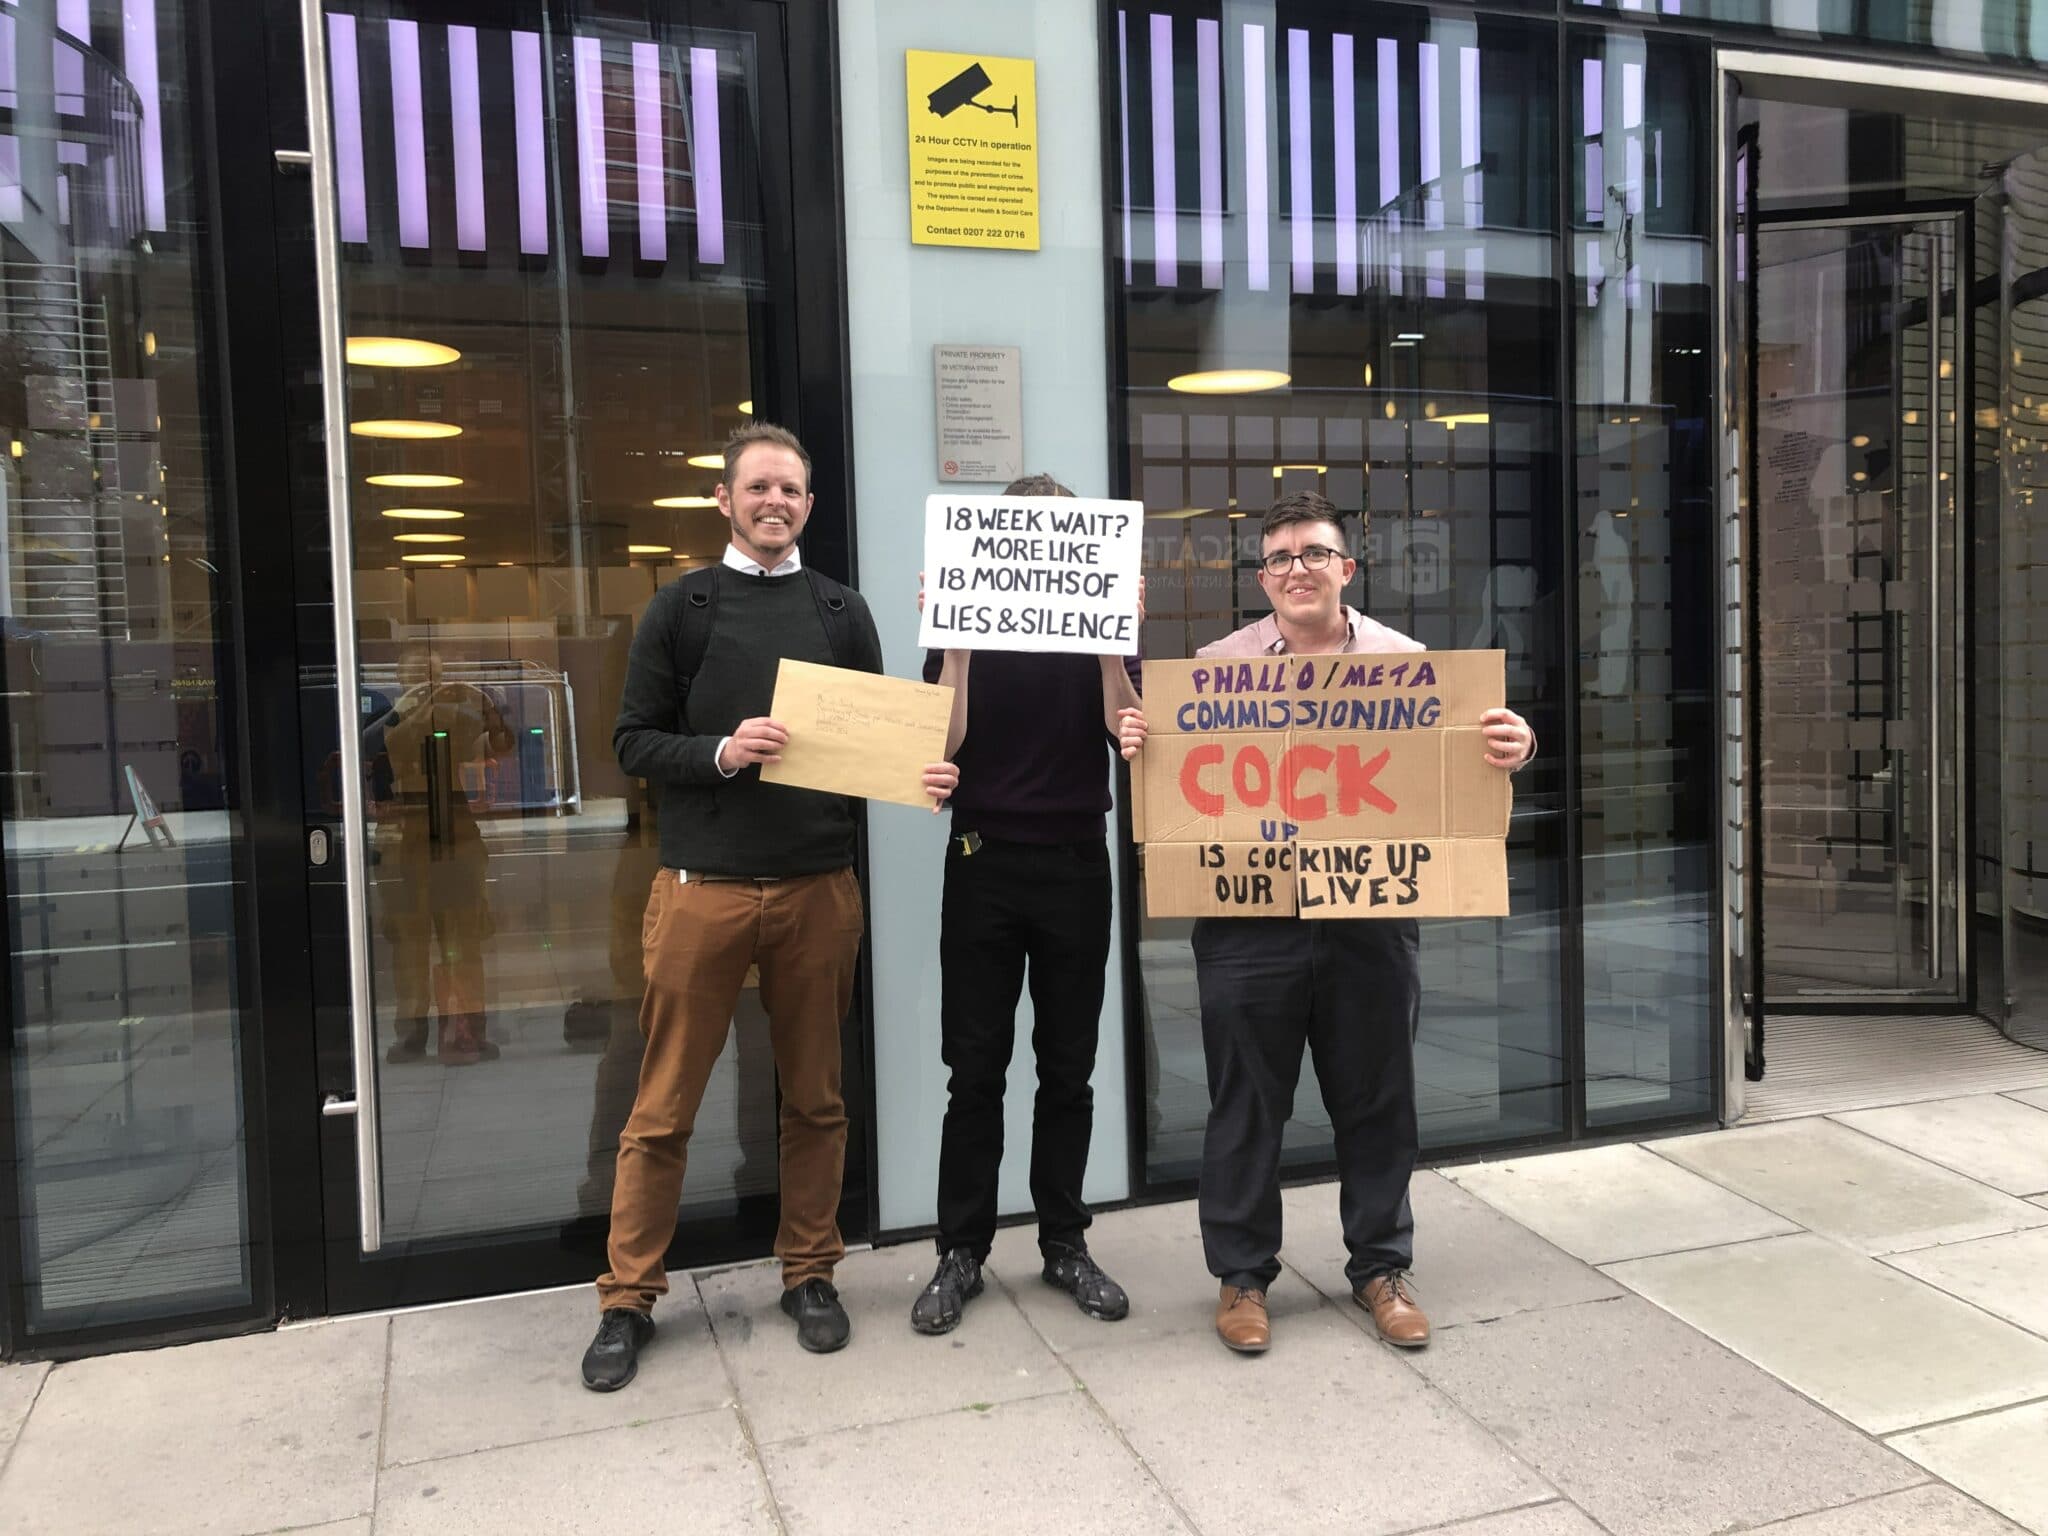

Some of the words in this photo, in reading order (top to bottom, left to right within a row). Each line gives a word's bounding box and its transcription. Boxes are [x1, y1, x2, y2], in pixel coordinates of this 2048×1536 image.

[915, 135, 926, 143] 24
[928, 135, 950, 145] Hour
[952, 137, 977, 147] CCTV
[990, 142, 1032, 151] operation
[926, 225, 961, 235] Contact
[963, 227, 984, 236] 0207
[986, 229, 1002, 237] 222
[1004, 230, 1025, 239] 0716
[941, 350, 968, 359] PRIVATE
[970, 351, 1006, 359] PROPERTY
[950, 364, 975, 372] VICTORIA
[946, 506, 973, 531] 18
[976, 508, 1044, 532] WEEK
[1049, 511, 1130, 538] WAIT?
[971, 536, 1044, 562] MORE
[1049, 540, 1101, 565] LIKE
[939, 567, 966, 591] 18
[971, 567, 1082, 595] MONTHS
[1083, 572, 1119, 599] OF
[932, 603, 993, 634] LIES
[996, 607, 1019, 633] &
[1020, 607, 1133, 641] SILENCE
[1176, 696, 1441, 732] COMMISSIONING
[1179, 743, 1398, 822] COCK
[1259, 819, 1300, 842] UP
[1199, 844, 1226, 869] IS
[1247, 844, 1373, 875] COCKING
[1386, 843, 1432, 880] UP
[1215, 873, 1274, 905] OUR
[1299, 876, 1420, 910] LIVES
